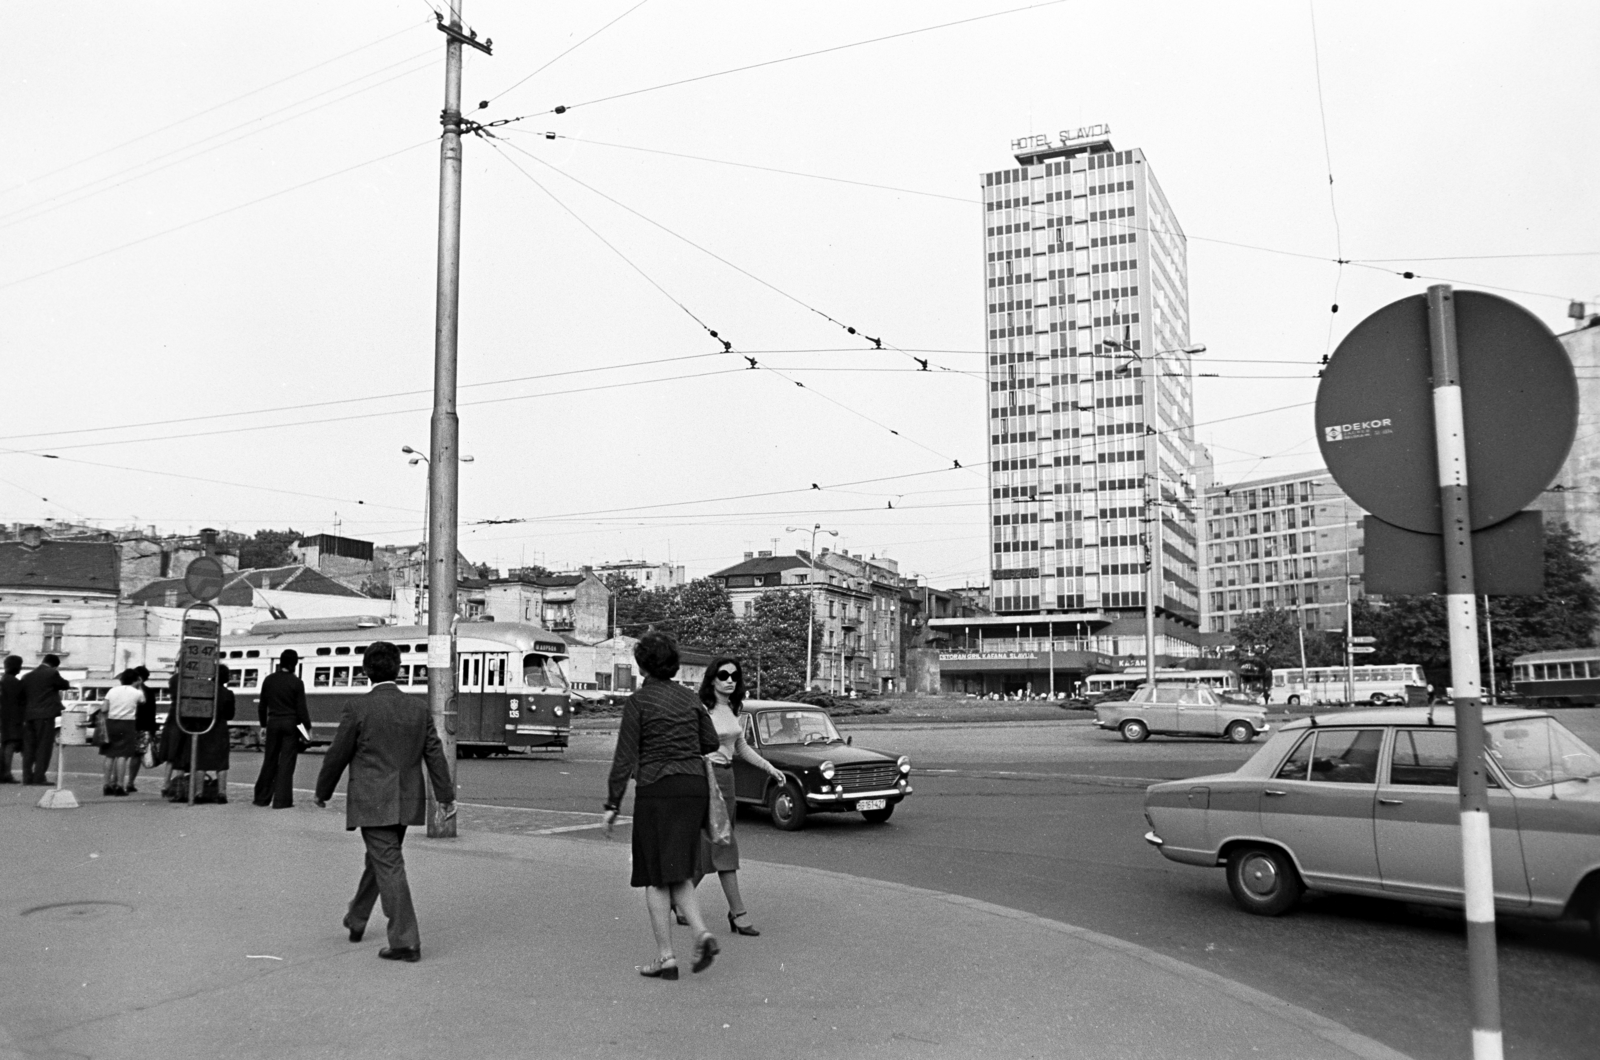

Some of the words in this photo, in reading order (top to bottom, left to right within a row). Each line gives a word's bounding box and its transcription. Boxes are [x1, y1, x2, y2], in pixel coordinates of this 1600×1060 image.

[1011, 134, 1049, 151] HOTEL
[1059, 123, 1111, 142] SLAVIJA
[1342, 418, 1392, 432] DEKOR
[188, 645, 199, 656] 13
[201, 646, 214, 657] 47
[939, 653, 967, 661] ESTORAN
[1119, 659, 1147, 667] KAFAN
